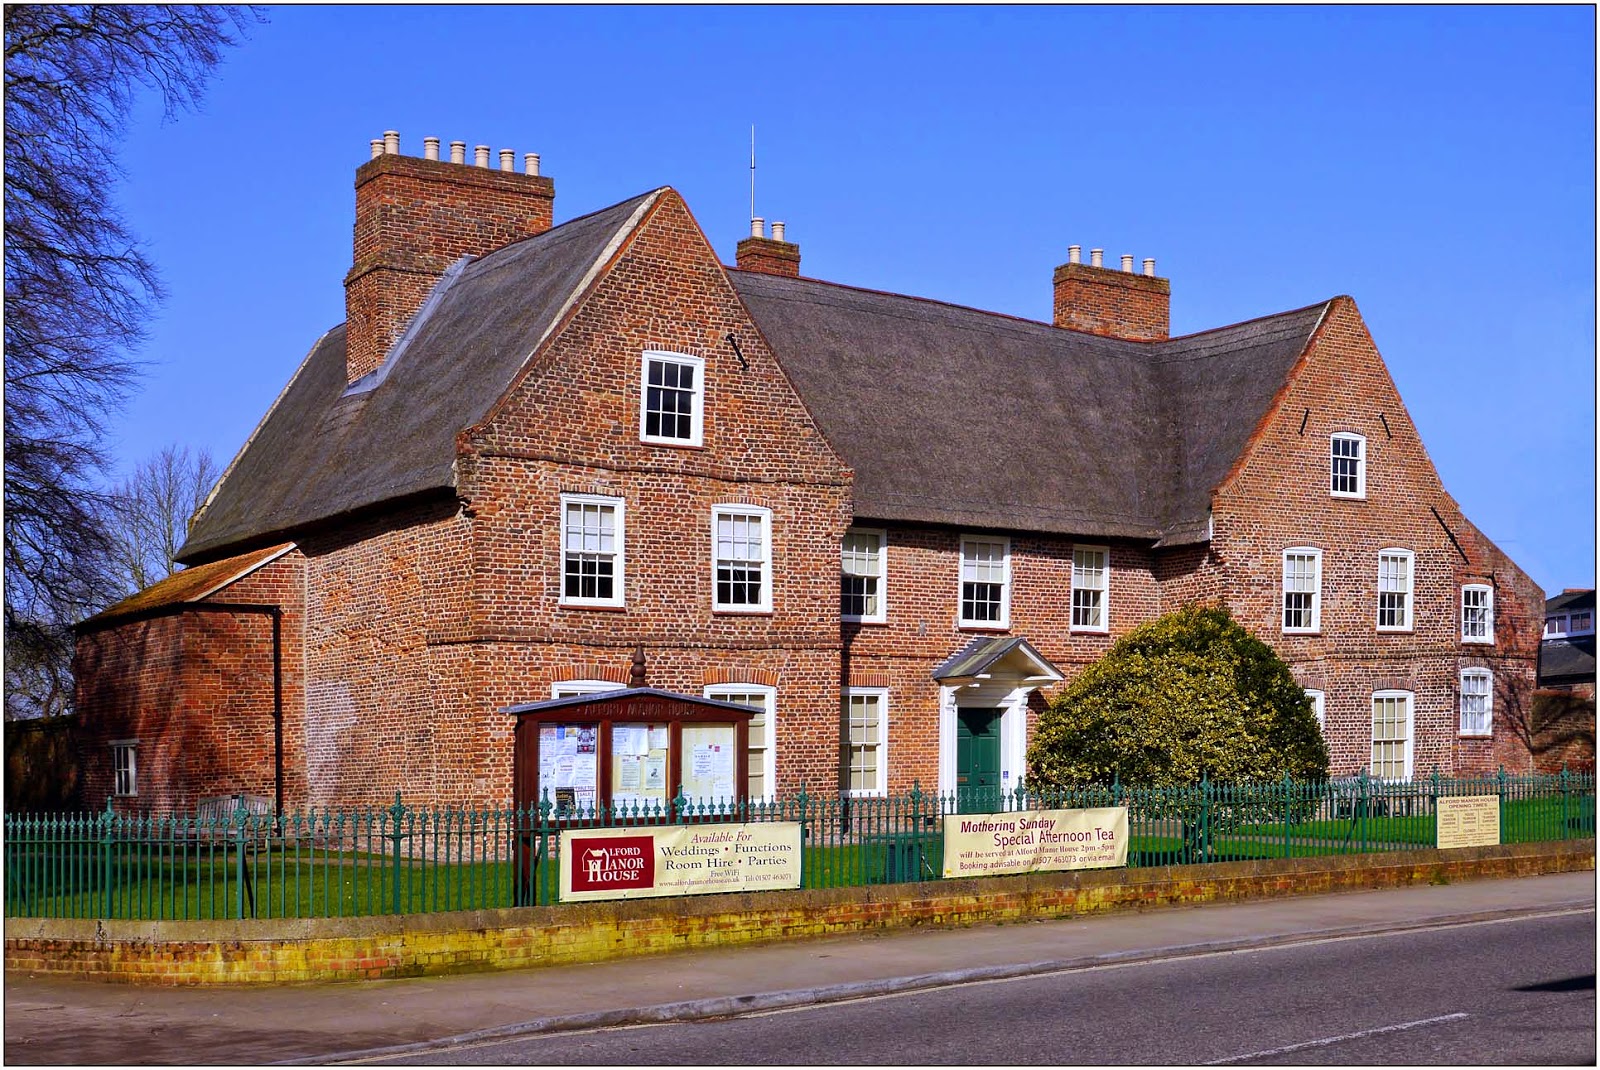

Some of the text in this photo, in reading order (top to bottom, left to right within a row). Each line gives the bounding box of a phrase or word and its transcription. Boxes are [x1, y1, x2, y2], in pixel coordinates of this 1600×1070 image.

[960, 817, 1056, 833] Mothering Sunday
[691, 831, 752, 844] Available For
[994, 827, 1114, 850] Special Afternoon Tea
[660, 842, 792, 857] Weddings Functions
[984, 850, 1006, 858] served
[1015, 848, 1038, 856] Alford
[1081, 845, 1096, 853] 2pm
[666, 856, 787, 870] Room Hire Parties
[960, 861, 988, 870] Booking
[990, 860, 1020, 869] advisable
[1031, 856, 1052, 865] 01507
[587, 859, 640, 882] HOUSE
